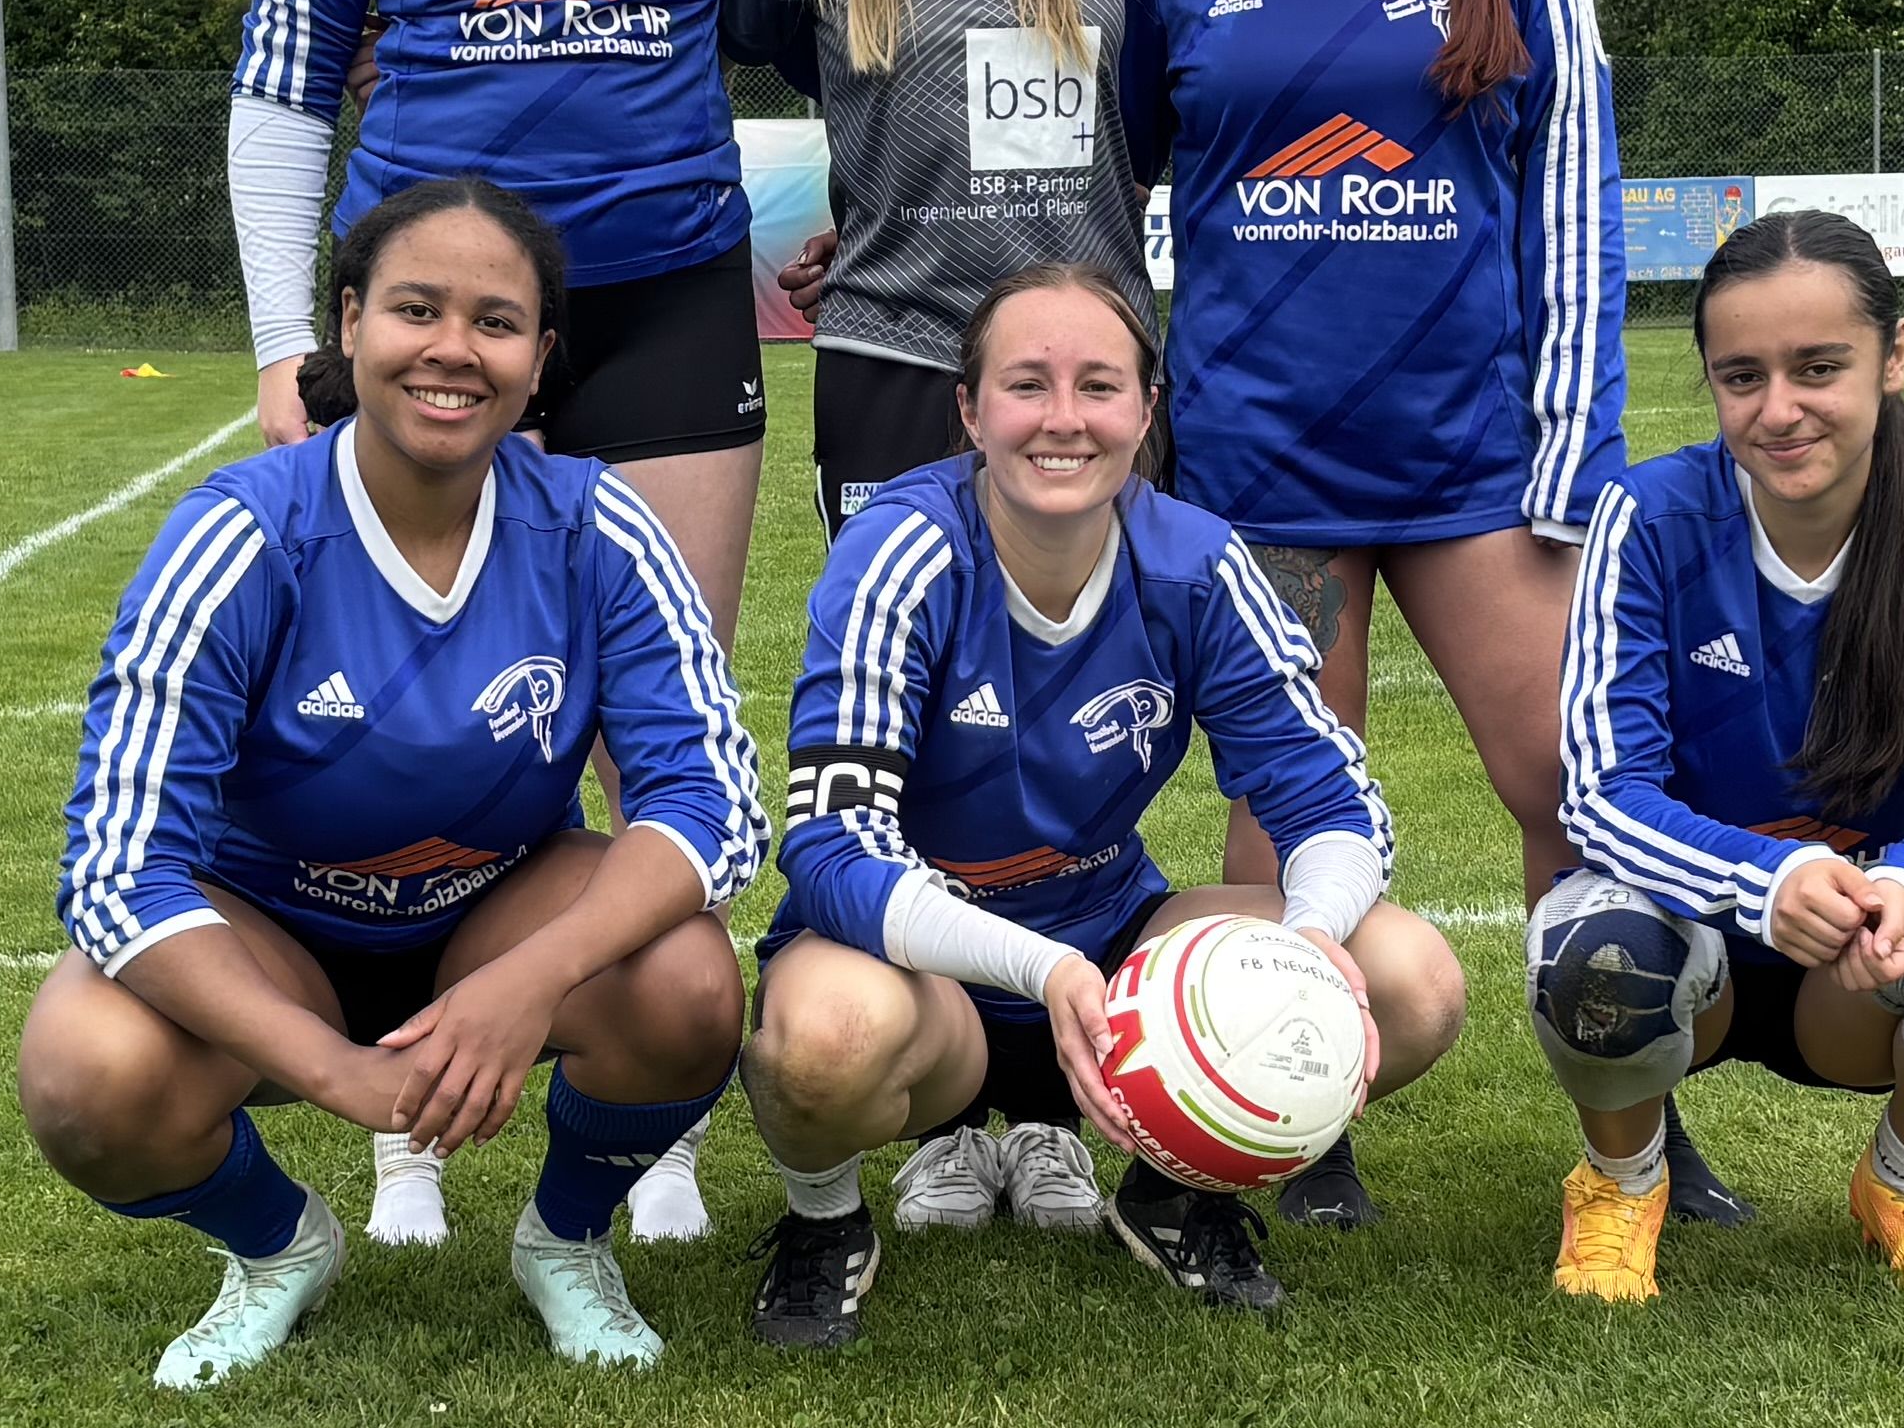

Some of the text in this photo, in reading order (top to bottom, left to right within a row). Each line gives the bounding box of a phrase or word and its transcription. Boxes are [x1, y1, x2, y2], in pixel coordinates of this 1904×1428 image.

[459, 0, 672, 41] VON ROHR
[450, 37, 673, 62] vonrohr-holzbau.ch
[984, 61, 1083, 120] bsb
[969, 176, 1006, 195] BSB
[1026, 174, 1093, 194] Partner
[1236, 174, 1458, 217] VON ROHR
[1654, 187, 1676, 203] AG
[900, 197, 1090, 224] Ingenieure und Planer
[1232, 219, 1459, 242] vonrohr-holzbau.ch
[1690, 651, 1751, 678] adidas
[297, 699, 365, 719] adidas
[950, 708, 1009, 728] adidas
[1240, 957, 1263, 970] FB
